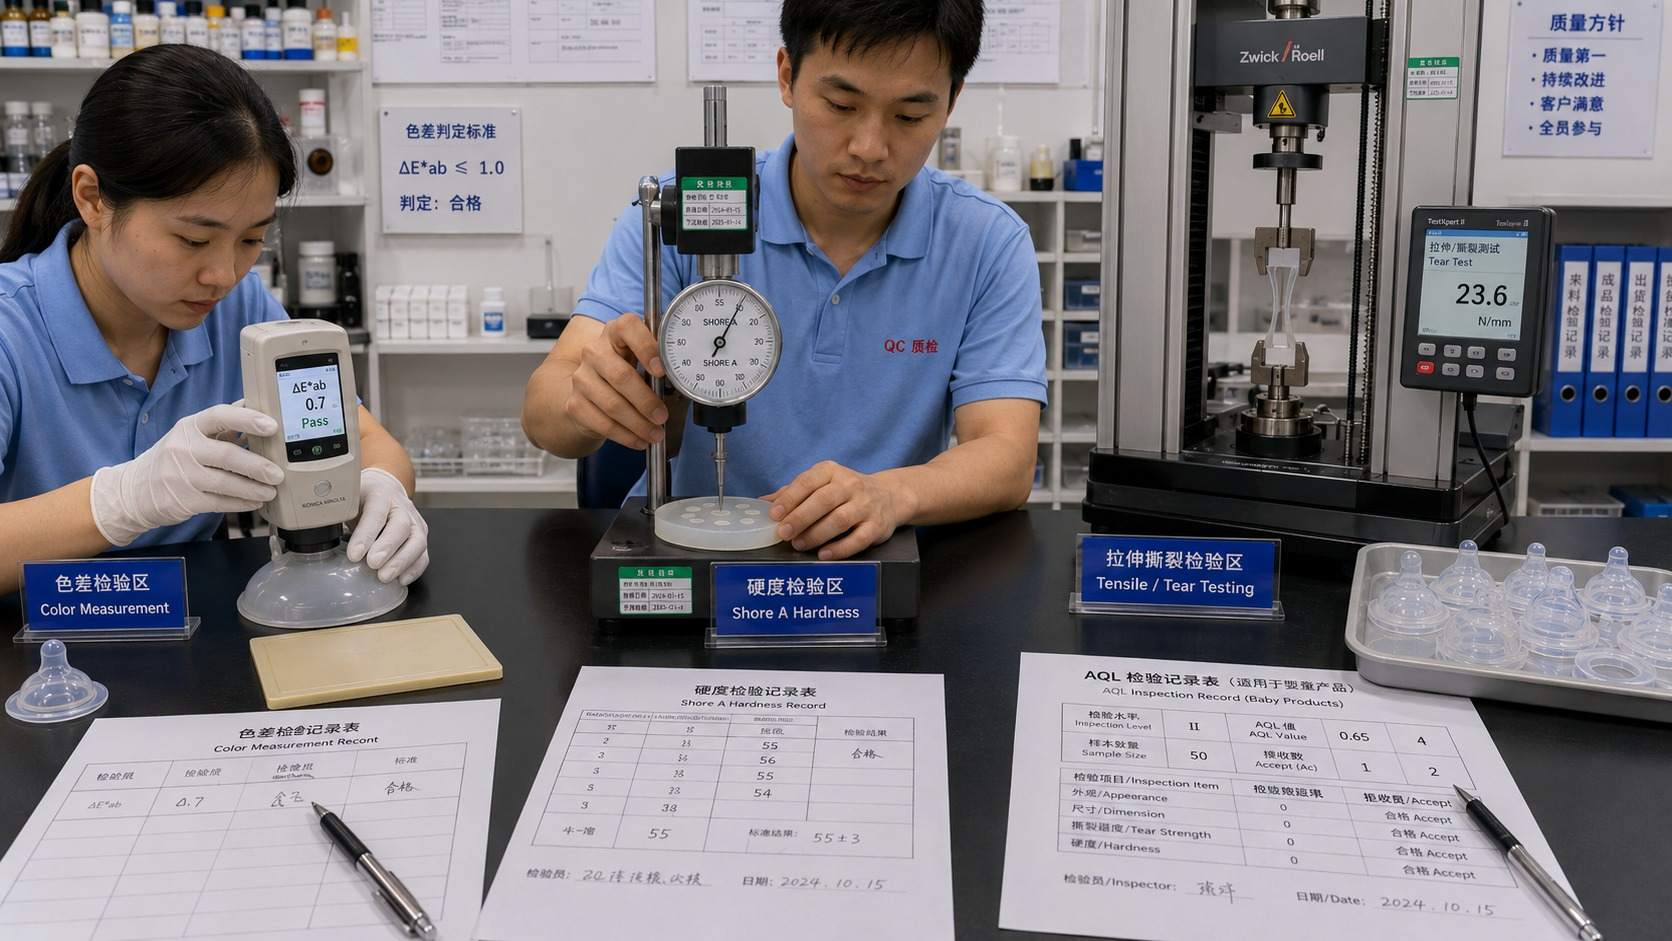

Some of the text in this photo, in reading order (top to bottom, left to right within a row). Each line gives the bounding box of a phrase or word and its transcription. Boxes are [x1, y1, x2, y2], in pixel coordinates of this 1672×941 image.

[1550, 13, 1625, 32] 质量方针
[1240, 49, 1325, 63] Zwick Roell
[1543, 47, 1606, 63] 质量第一
[1542, 71, 1605, 87] 持续改进
[1540, 96, 1604, 112] 客户满意
[406, 123, 495, 139] 色差判定标准
[1539, 120, 1601, 136] 全员参与
[480, 160, 505, 175] 1.0
[1428, 256, 1472, 267] Tear Test
[1456, 283, 1507, 307] 23.6
[703, 318, 730, 326] SHORE
[1478, 316, 1512, 328] N/mm
[884, 339, 938, 354] QC 质检
[703, 359, 738, 367] SHORE A
[305, 396, 325, 411] 0.7
[302, 416, 329, 429] Pass
[1106, 548, 1243, 571] 拉伸撕裂检验区
[55, 573, 151, 593] 色差检验区
[747, 577, 844, 596] 硬度检验区
[1096, 576, 1255, 598] Tensile / Tear Testing
[40, 601, 171, 617] Color Measurement
[732, 605, 860, 619] Shore A Hardness
[1084, 670, 1121, 683] AQL
[1126, 672, 1220, 687] 检验记录表
[694, 684, 817, 698] 硬度检验记录表
[1102, 686, 1345, 709] AQL Inspection Record (Baby Products)
[681, 698, 827, 710] Shore A Hardness Record
[1075, 720, 1153, 731] Inspection Level
[1189, 721, 1202, 733] II
[1255, 720, 1280, 731] AQL
[1249, 730, 1308, 742] AQL Value
[1339, 730, 1371, 743] 0.65
[1417, 735, 1428, 747] 4
[214, 744, 248, 753] Color
[251, 740, 335, 752] Measurement
[761, 741, 779, 751] 55
[759, 755, 777, 765] 56
[1082, 749, 1148, 761] Sample Size
[1190, 750, 1209, 763] 50
[1255, 761, 1318, 774] Accept (Ac)
[1361, 762, 1371, 774] 1
[1428, 767, 1440, 779] 2
[756, 771, 774, 781] 55
[1193, 780, 1219, 791] Item
[753, 788, 772, 799] 54
[1413, 814, 1453, 826] Accept
[648, 827, 673, 840] 55
[1160, 828, 1212, 841] Strength
[1419, 831, 1460, 844] Accept
[1426, 849, 1468, 863] Accept
[1433, 867, 1477, 881] Accept
